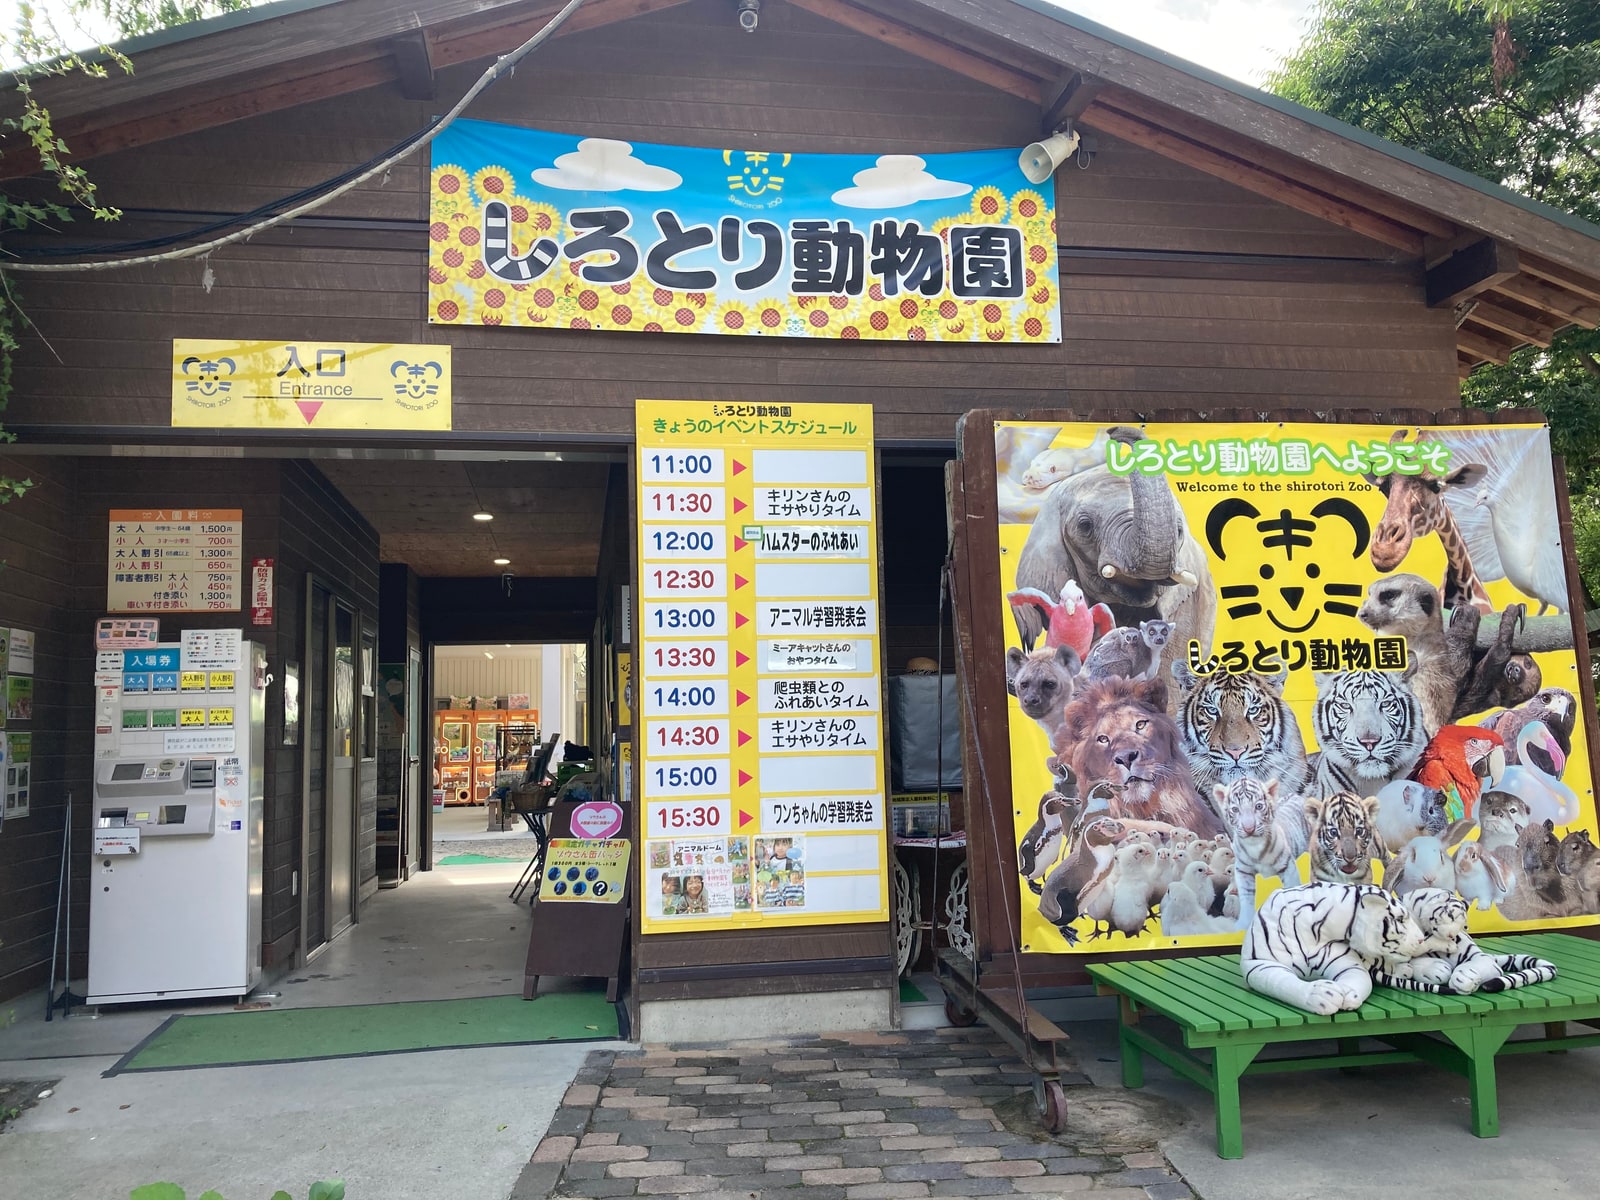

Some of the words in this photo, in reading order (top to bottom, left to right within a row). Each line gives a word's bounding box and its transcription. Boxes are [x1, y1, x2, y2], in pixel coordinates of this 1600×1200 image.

[486, 201, 1024, 297] しろとり動物園
[277, 346, 346, 378] 入口
[279, 381, 352, 396] Entrance
[186, 395, 216, 408] SHIROTORI
[218, 395, 232, 408] ZOO
[394, 398, 424, 411] SHIROTORI
[426, 399, 439, 410] ZOO
[714, 404, 791, 418] しろとり動物園
[653, 418, 857, 435] きょうのイベントスケジュール
[652, 455, 712, 474] 11:00
[1109, 440, 1449, 474] しろとり動物園へようこそ
[1176, 481, 1238, 492] Welcome
[1243, 481, 1256, 492] to
[1259, 481, 1282, 492] the
[1286, 481, 1345, 492] shirotori
[1349, 481, 1372, 492] Zoo
[652, 493, 712, 513] 11:30
[768, 489, 851, 502] キリンさんの
[768, 503, 861, 517] エサやりタイム
[201, 525, 233, 534] 1,500円
[208, 537, 233, 545] 700円
[653, 531, 714, 551] 12:00
[761, 532, 858, 551] ハムスターのふれあい
[115, 549, 163, 558] 大人割引
[200, 549, 232, 558] 1,300円
[115, 561, 163, 570] 小人割引
[208, 561, 232, 569] 650円
[654, 570, 714, 589] 12:30
[153, 591, 188, 599] 付き添い
[200, 592, 232, 600] 1,300円
[207, 601, 231, 609] 750円
[655, 609, 715, 628] 13:00
[770, 606, 867, 628] アニマル学習発表会
[773, 643, 851, 653] ミーアキャットさんの
[1189, 637, 1407, 674] しろとり動物園
[131, 655, 171, 667] 入場券
[655, 647, 716, 667] 13:30
[787, 655, 837, 665] おやつタイム
[127, 676, 145, 684] 大人
[774, 681, 845, 695] 爬虫類との
[654, 687, 716, 707] 14:00
[774, 695, 869, 709] ふれあいタイム
[771, 719, 856, 734] キリンさんの
[657, 726, 720, 747] 14:30
[772, 733, 867, 748] エサやりタイム
[655, 766, 717, 787] 15:00
[658, 806, 720, 828] 15:30
[773, 800, 873, 825] ワンちゃんの学習発表会
[677, 844, 722, 853] アニマルドーム
